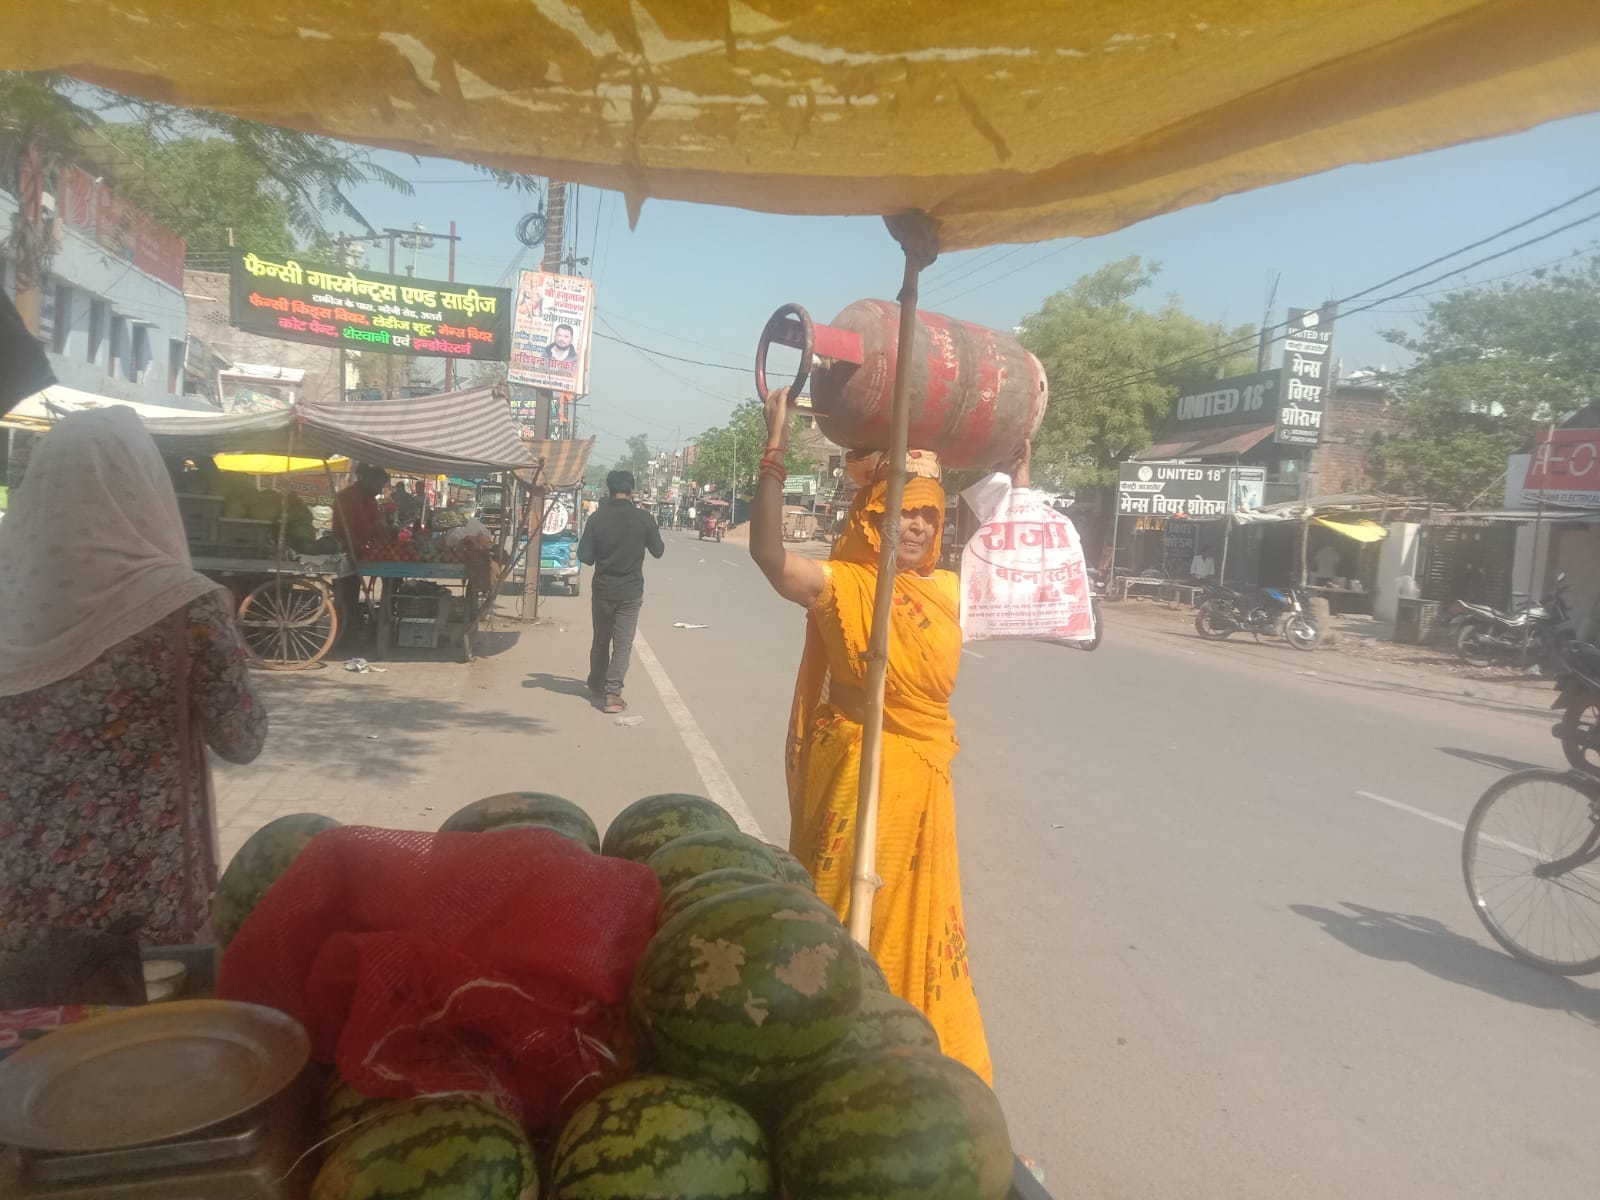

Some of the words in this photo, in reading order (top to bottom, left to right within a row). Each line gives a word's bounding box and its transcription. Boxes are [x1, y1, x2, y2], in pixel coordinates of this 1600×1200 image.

[243, 252, 303, 285] फैन्सी
[306, 271, 397, 303] गारमेन्ट्स
[400, 286, 437, 308] एण्ड
[440, 288, 496, 317] साड़ीज
[249, 292, 288, 312] फैन्सी
[372, 314, 410, 331] लेडीज
[278, 316, 308, 331] कोट
[342, 326, 390, 344] शेरवानी
[392, 334, 410, 347] एवं
[1292, 353, 1322, 378] मेन्स
[1288, 378, 1322, 402] वियर
[1177, 388, 1239, 420] UNITED
[1158, 468, 1203, 481] UNITED
[1120, 492, 1150, 513] मेन्स
[1153, 494, 1185, 514] वियर
[979, 521, 1070, 551] राजा
[995, 568, 1039, 585] बटन
